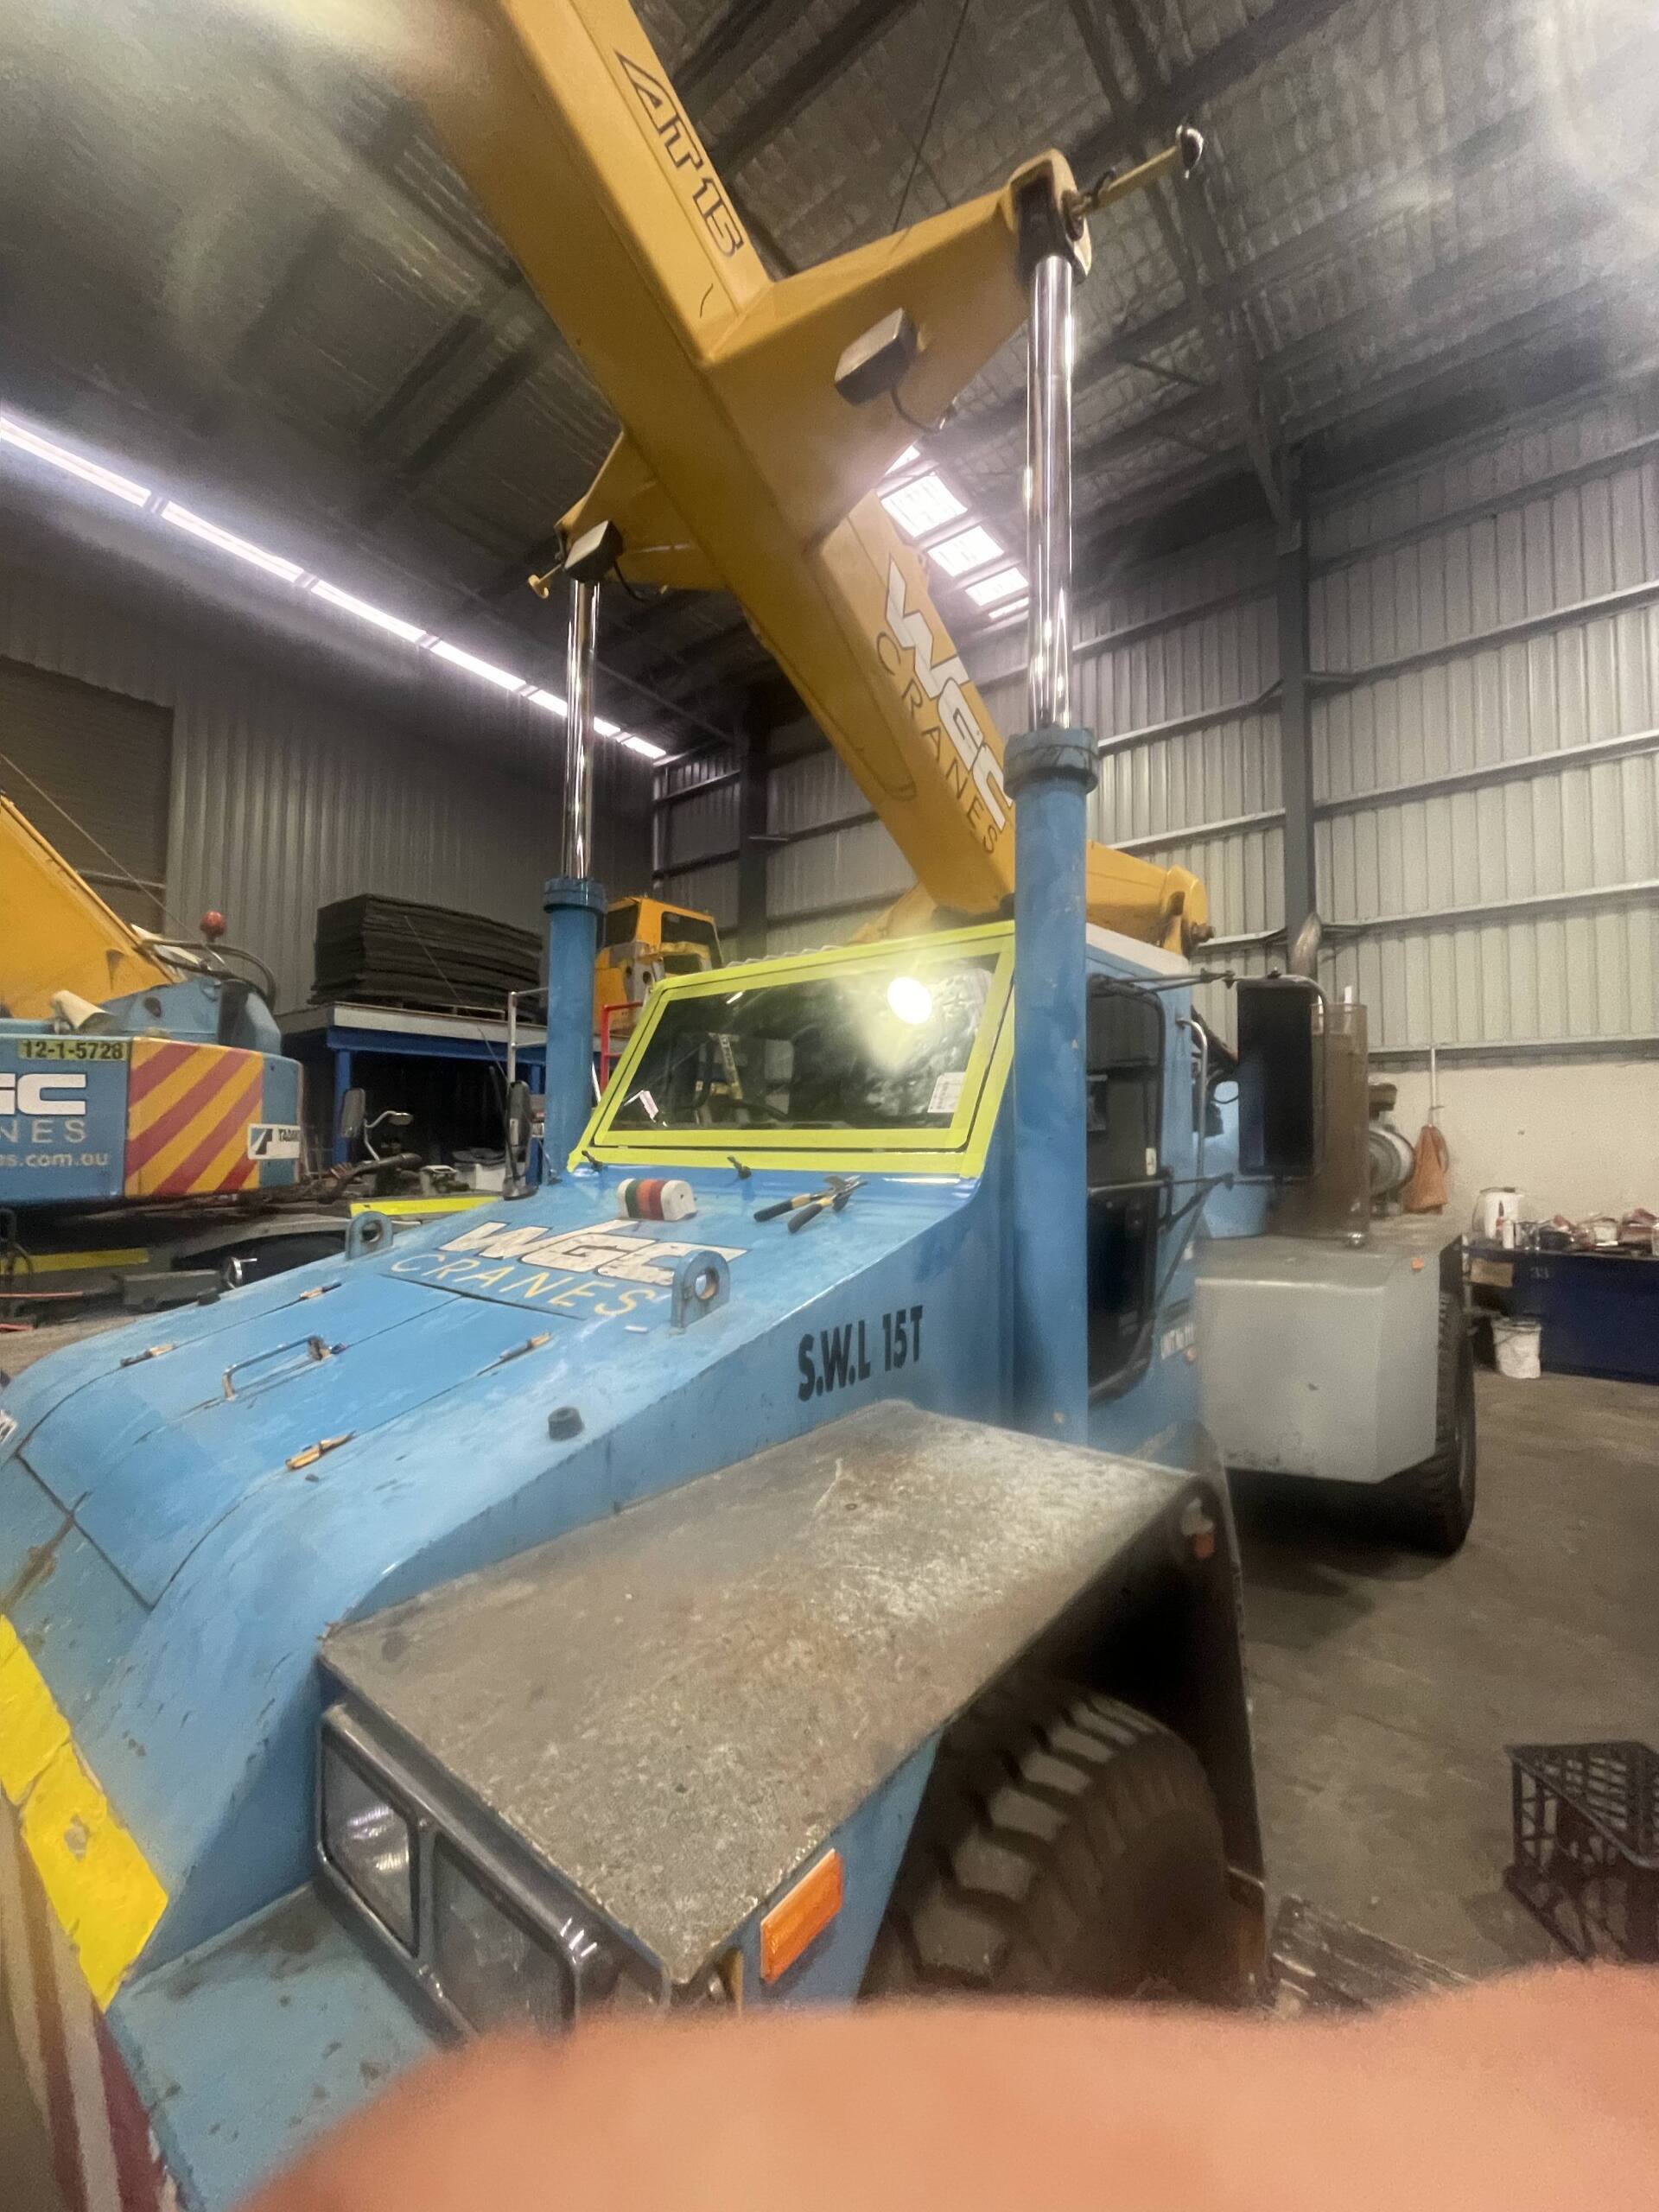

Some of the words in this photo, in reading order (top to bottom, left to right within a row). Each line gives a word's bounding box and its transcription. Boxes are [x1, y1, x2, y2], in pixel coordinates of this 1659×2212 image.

[875, 631, 998, 854] CRANES
[22, 1040, 125, 1060] 12-1-5728
[391, 1253, 658, 1317] CRANES
[436, 1219, 752, 1287] WGC
[798, 1319, 872, 1402] S.W.L
[881, 1304, 924, 1372] 15T
